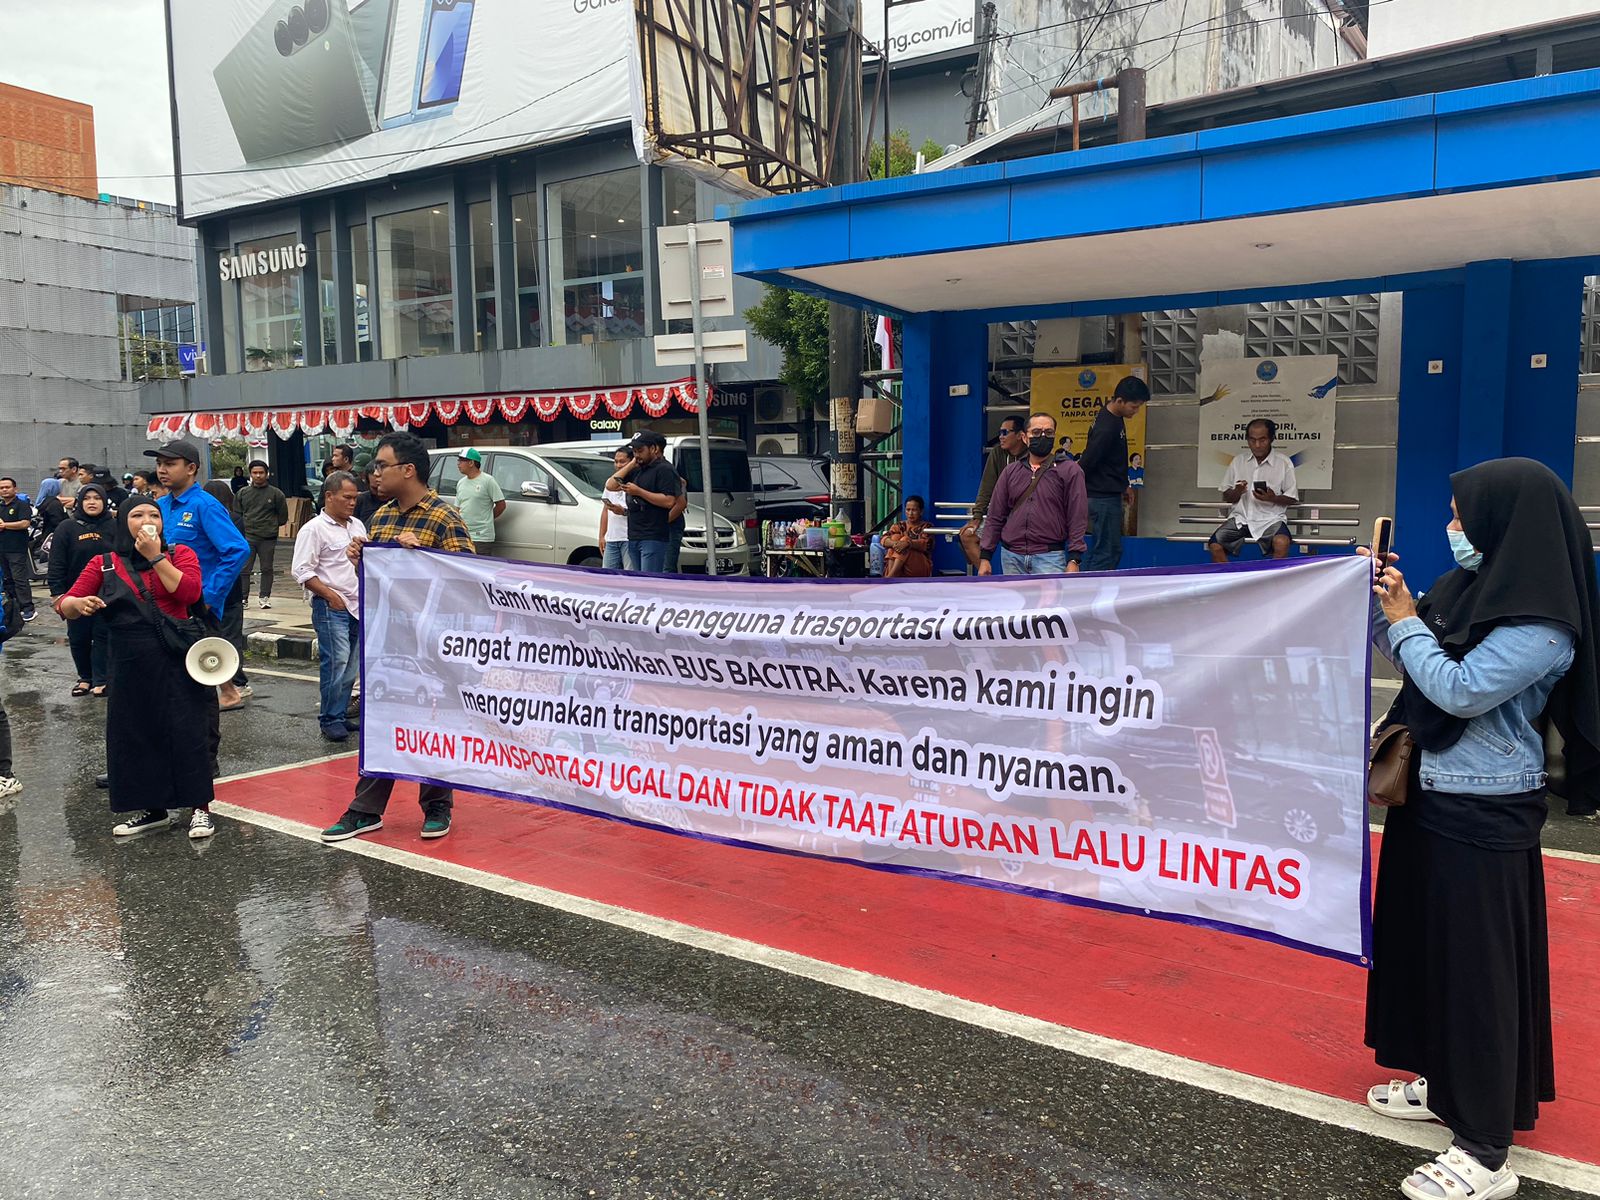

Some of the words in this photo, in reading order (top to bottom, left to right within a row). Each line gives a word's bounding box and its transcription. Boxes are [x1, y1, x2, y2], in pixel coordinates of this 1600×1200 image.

[219, 243, 307, 281] SAMSUNG
[713, 392, 748, 407] SUNG
[1061, 410, 1086, 418] TANPA
[590, 419, 622, 432] Galaxy
[1273, 432, 1321, 441] BILITASI
[482, 582, 530, 609] Kami
[531, 593, 656, 626] masyarakat
[655, 605, 785, 639] pengguna
[790, 608, 950, 645] trasportasi
[953, 612, 1069, 641] umum
[442, 634, 511, 666] sangat
[517, 639, 673, 677] membutuhkan
[671, 654, 725, 683] BUS
[725, 659, 855, 693] BACITRA.
[857, 668, 967, 702] Karena
[975, 669, 1057, 711] kami
[1066, 670, 1155, 726] ingin
[461, 689, 607, 726] menggunakan
[613, 703, 753, 747] transportasi
[757, 723, 820, 764] yang
[826, 733, 903, 768] aman
[911, 735, 967, 777] dan
[976, 749, 1127, 794] nyaman.
[394, 727, 456, 760] BUKAN
[461, 736, 604, 789] TRANSPORTASI
[610, 760, 672, 799] UGAL
[678, 771, 733, 810] DAN
[738, 781, 817, 825] TIDAK
[823, 794, 896, 838] TAAT
[898, 808, 1040, 856] ATURAN
[1049, 826, 1145, 873] LALU
[1158, 838, 1301, 900] LINTAS
